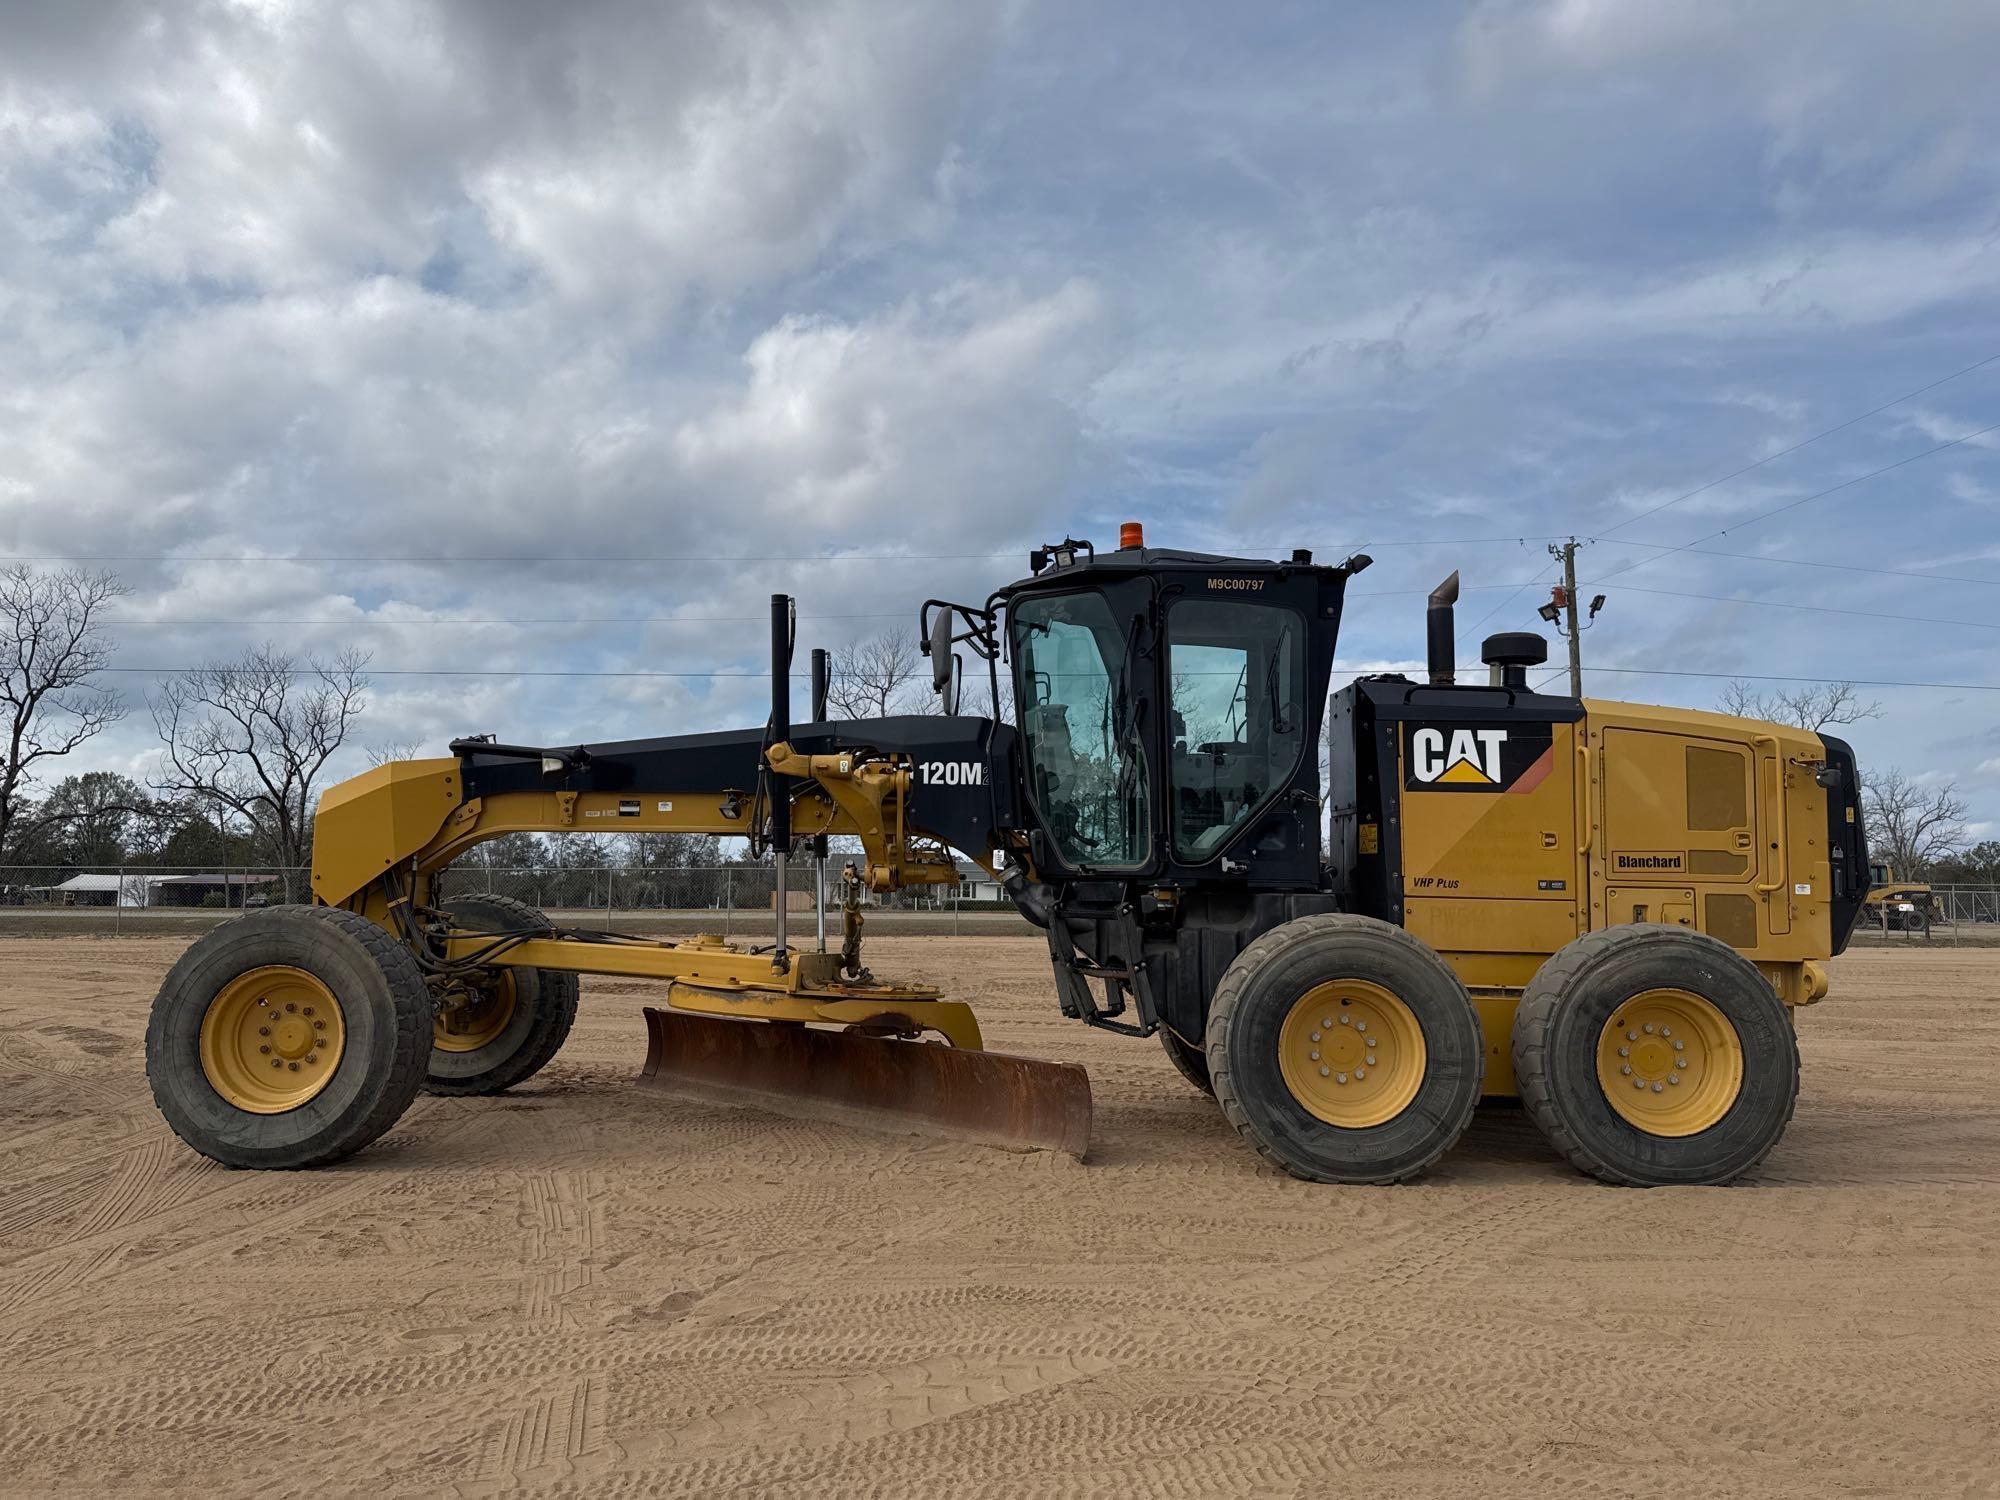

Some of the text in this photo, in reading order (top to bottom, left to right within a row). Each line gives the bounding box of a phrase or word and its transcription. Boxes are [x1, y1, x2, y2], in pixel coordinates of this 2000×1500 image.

[1207, 578, 1265, 591] M9C00797
[1413, 728, 1508, 784] CAT
[1618, 855, 1681, 868] Blanchard
[1413, 877, 1434, 888] VHP
